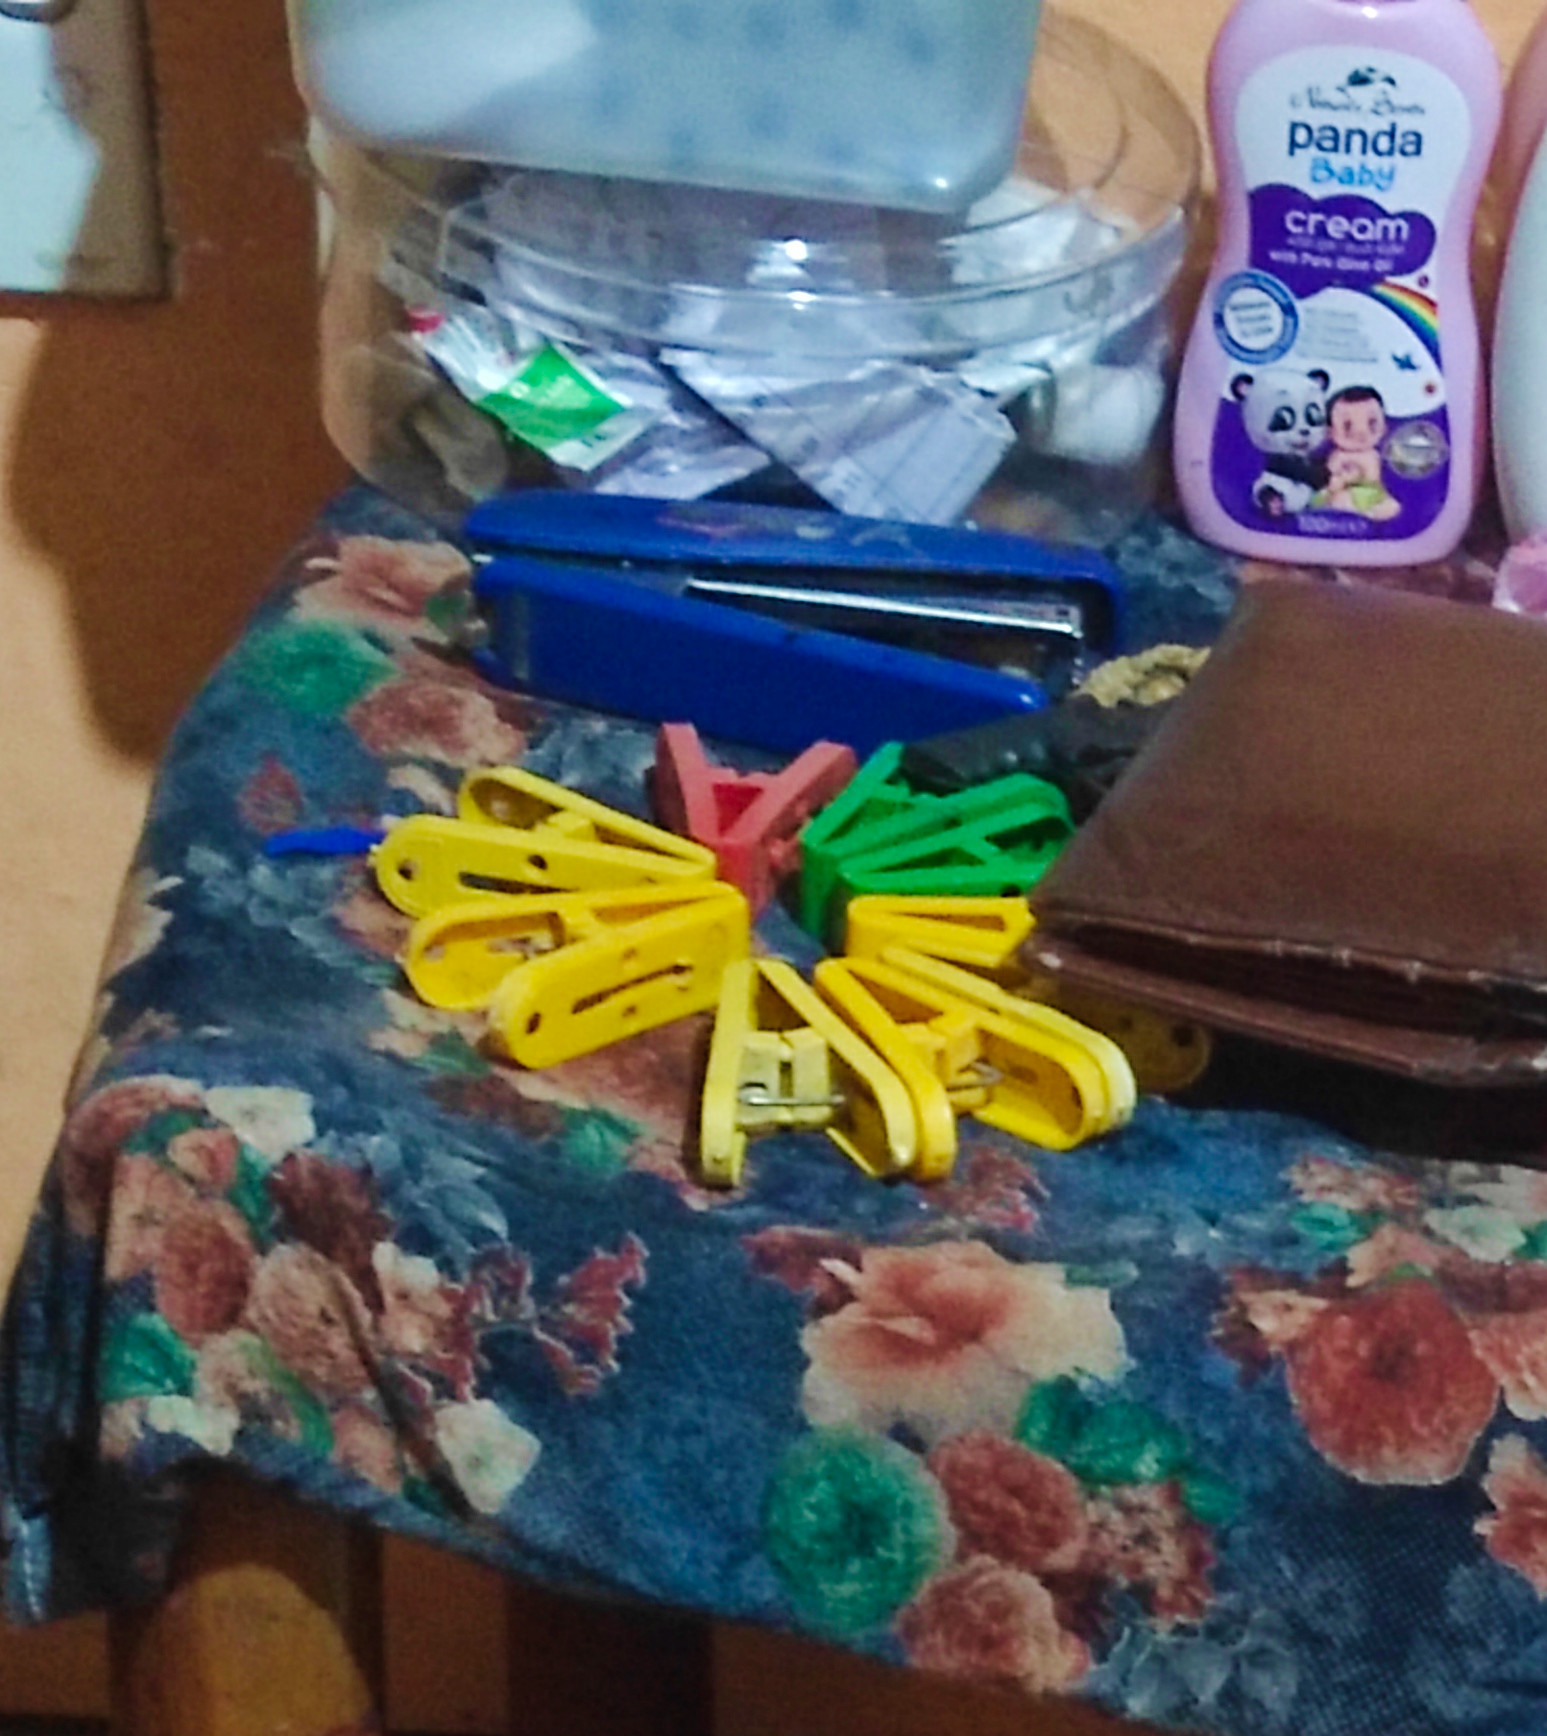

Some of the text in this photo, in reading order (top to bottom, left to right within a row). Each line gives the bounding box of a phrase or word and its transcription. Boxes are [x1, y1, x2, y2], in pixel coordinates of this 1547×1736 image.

[1288, 121, 1423, 157] panda
[1310, 157, 1395, 191] Baby
[1285, 210, 1410, 241] cream
